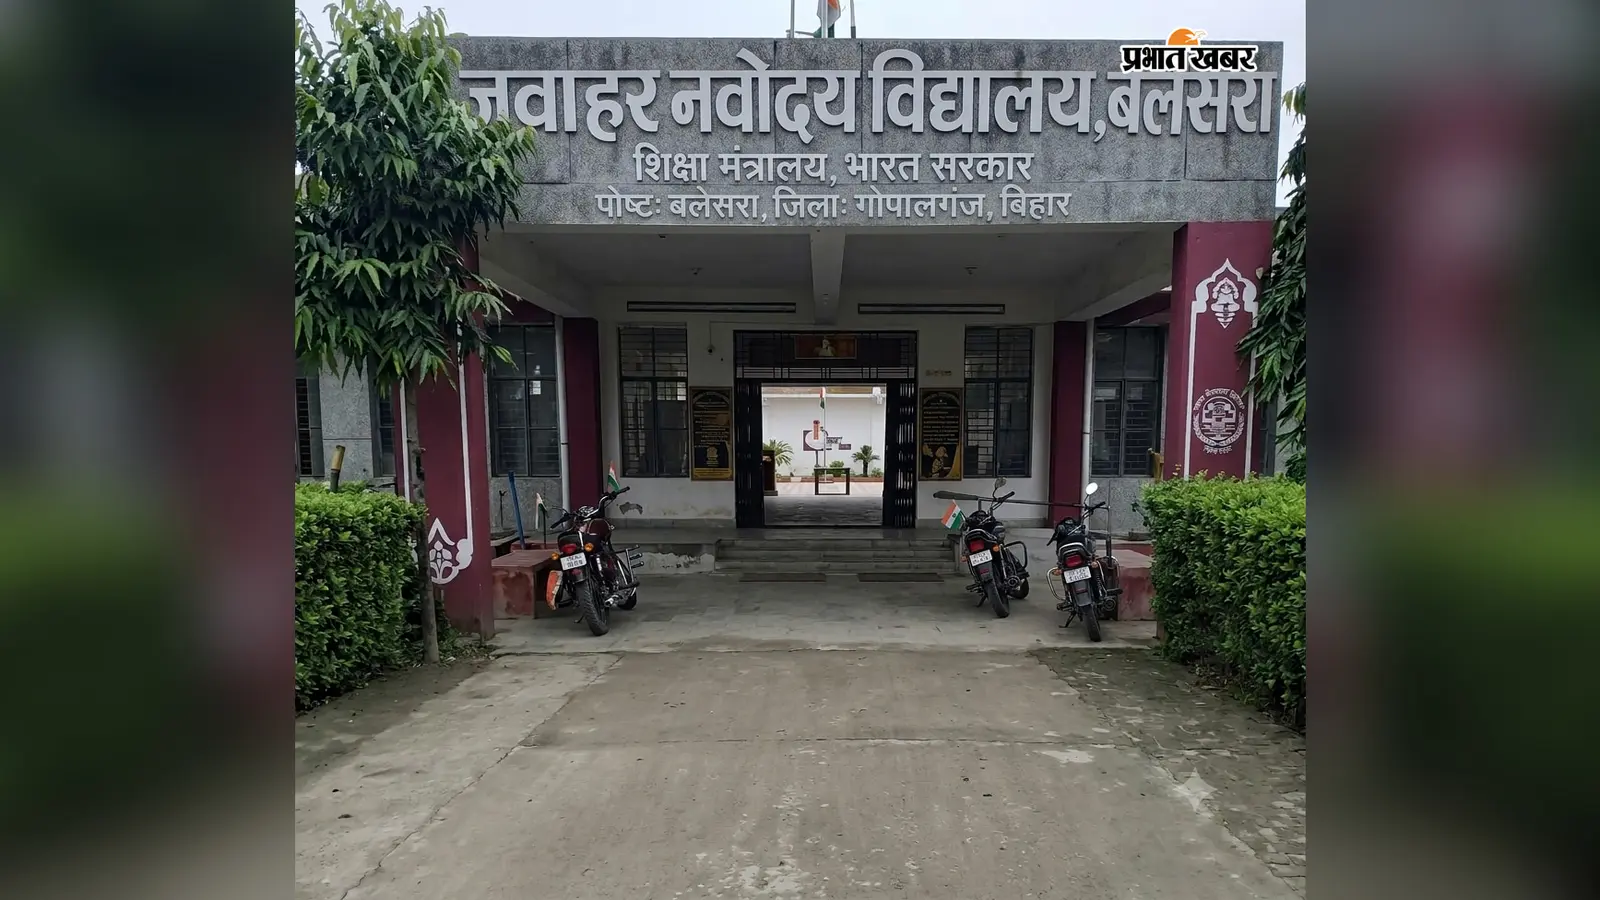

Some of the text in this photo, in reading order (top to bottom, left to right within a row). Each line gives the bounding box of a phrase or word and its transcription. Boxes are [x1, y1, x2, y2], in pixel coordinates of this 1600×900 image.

[459, 70, 661, 142] जवाहर
[669, 47, 861, 144] नवोदय
[632, 142, 1035, 187] शिक्षा मंत्रालय, भारत सरकार
[667, 185, 768, 222] बलेसरा,
[853, 185, 993, 222] गोपालगंज,
[999, 184, 1073, 220] बिहार
